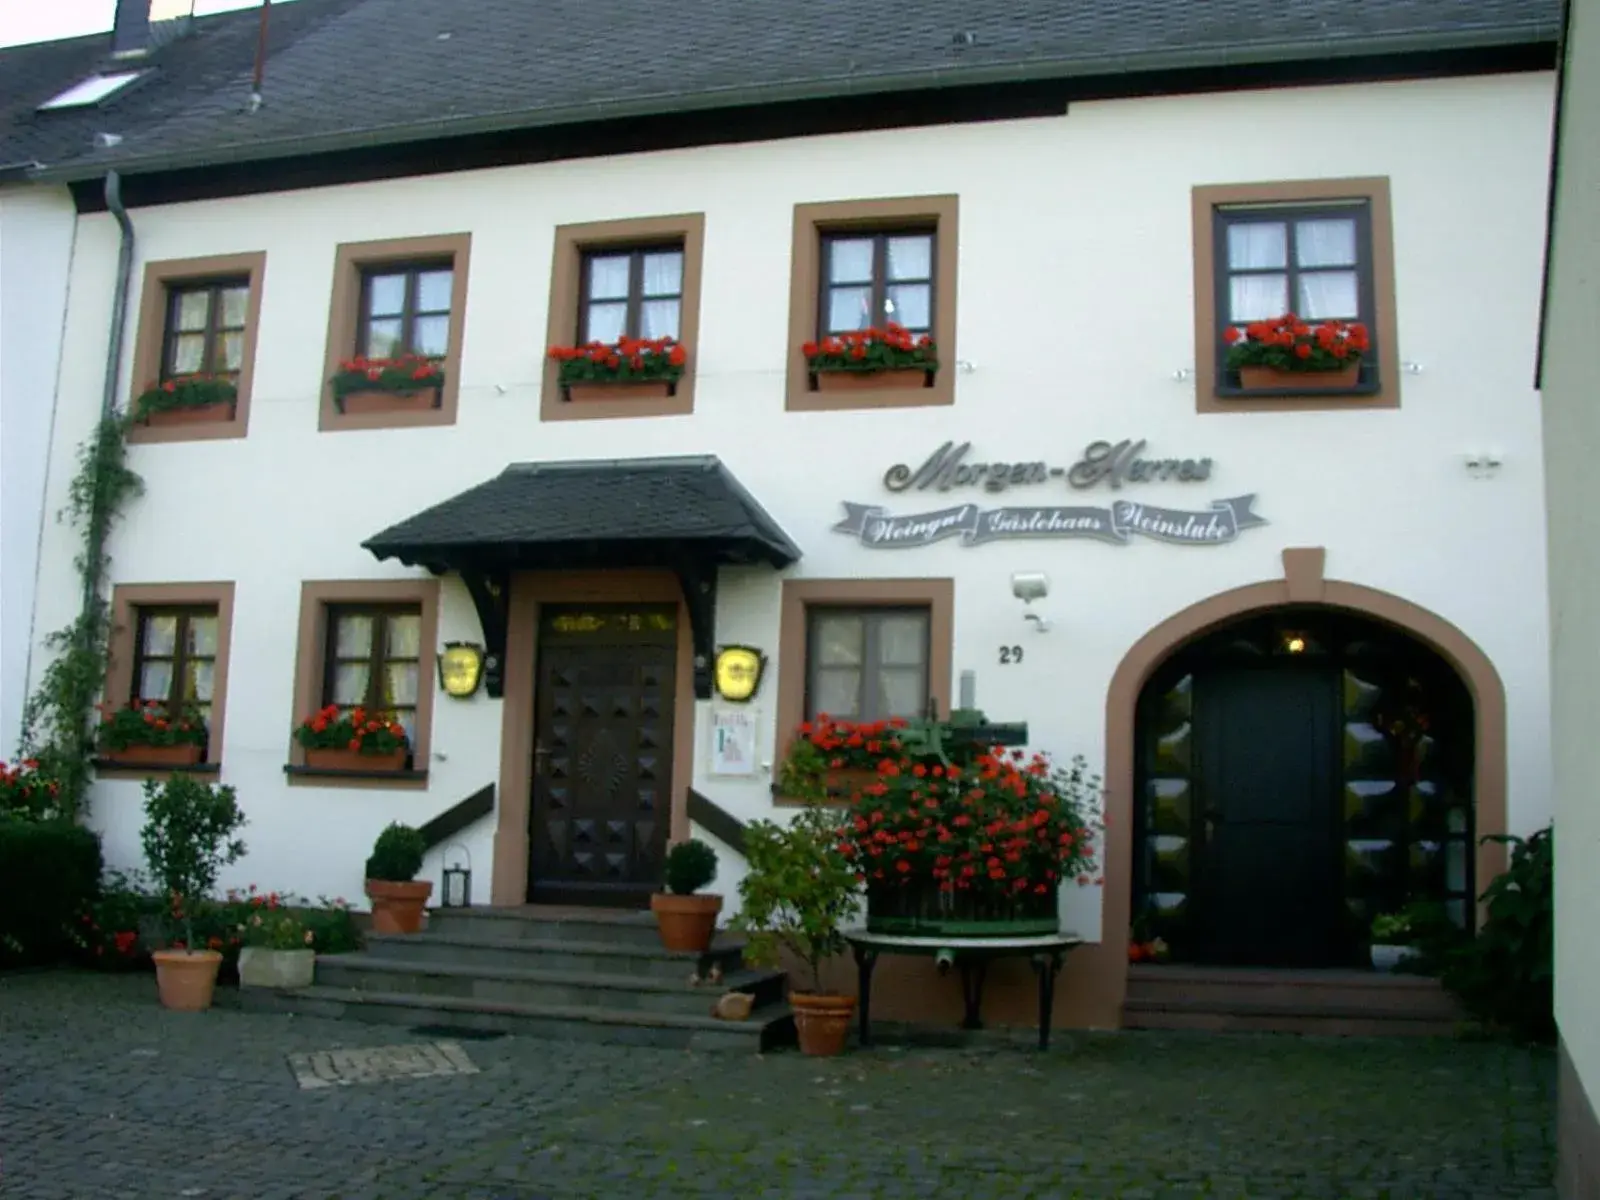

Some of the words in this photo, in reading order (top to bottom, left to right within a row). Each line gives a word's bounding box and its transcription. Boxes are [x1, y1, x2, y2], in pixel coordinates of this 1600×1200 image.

[883, 439, 1213, 493] Morgen-Herres
[870, 506, 969, 542] Weingut
[988, 509, 1102, 533] Gästehaus
[1119, 502, 1229, 540] Weinstube
[998, 645, 1024, 665] 29
